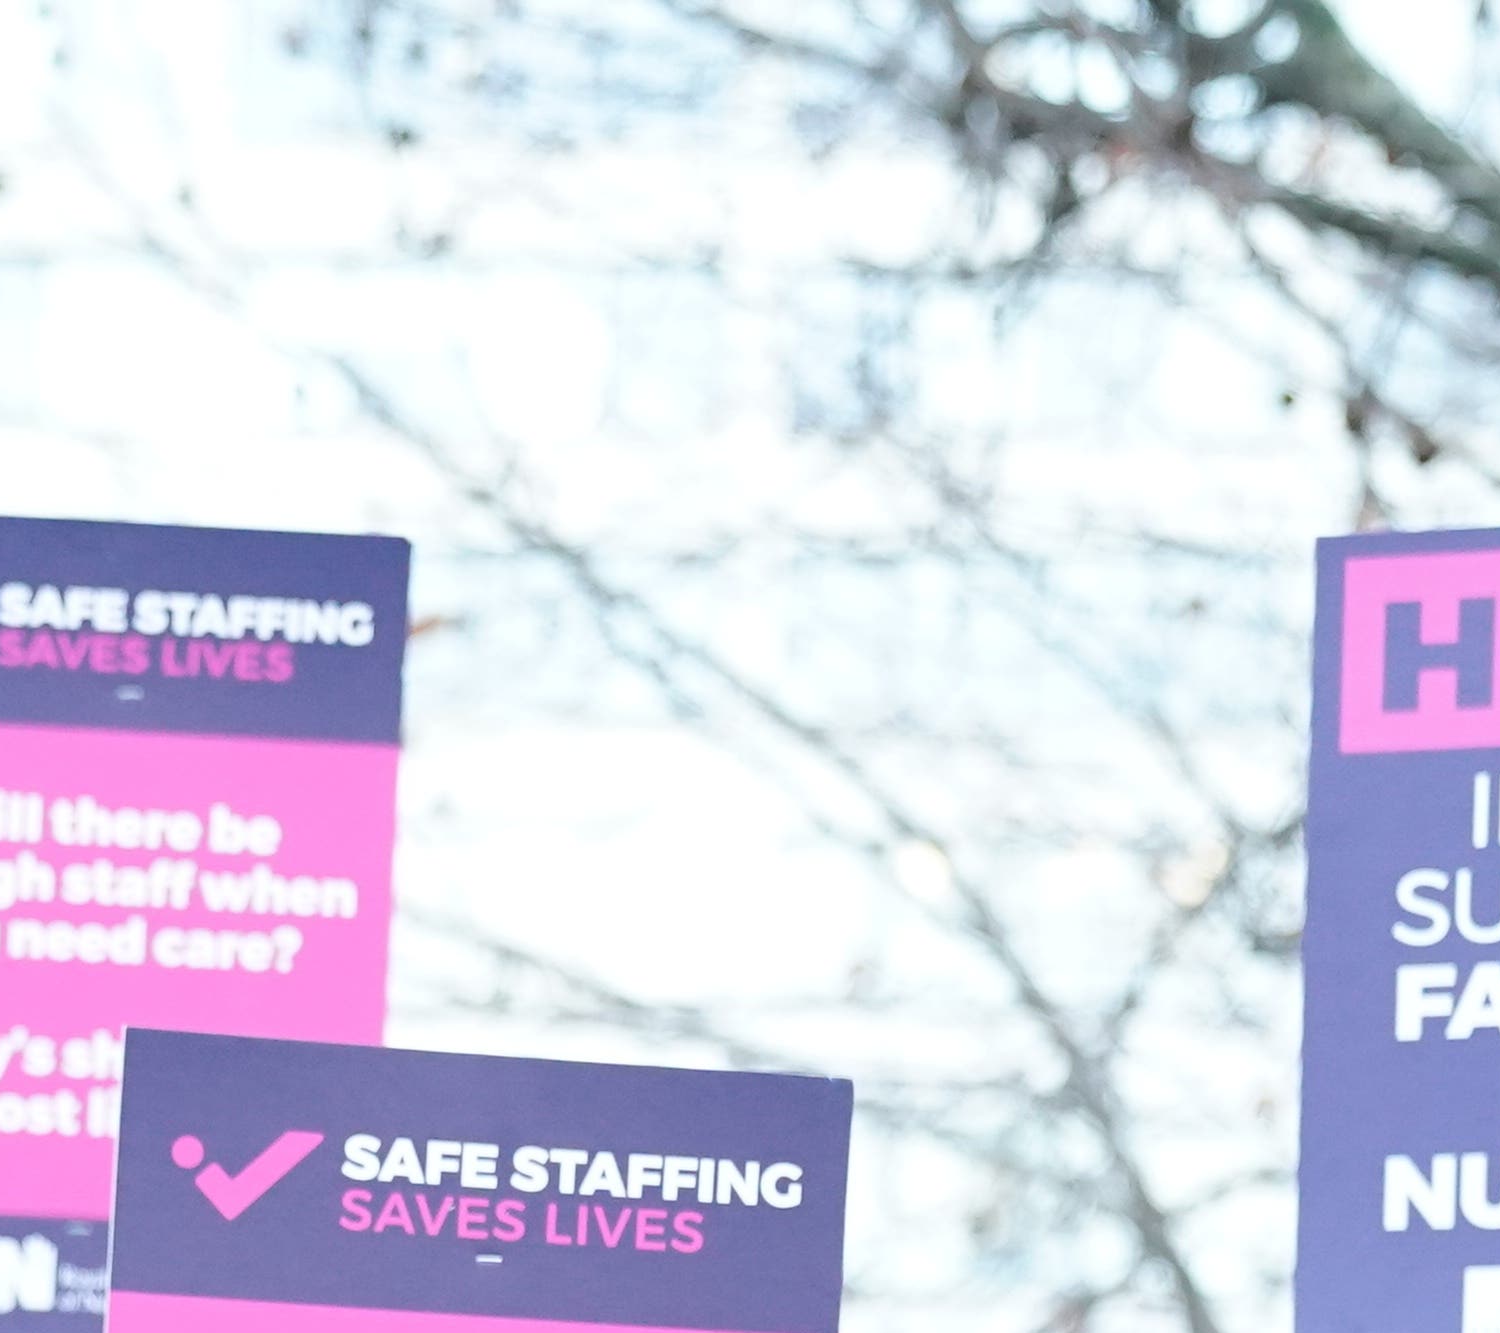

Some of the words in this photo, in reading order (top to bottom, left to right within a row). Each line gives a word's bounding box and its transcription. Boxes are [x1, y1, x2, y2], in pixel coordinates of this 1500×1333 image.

[138, 588, 374, 648] STAFFING
[161, 637, 296, 684] LIVES
[51, 793, 201, 853] there
[211, 802, 282, 857] be
[61, 853, 199, 910] staff
[199, 862, 358, 918] when
[7, 908, 144, 966] need
[152, 923, 304, 975] care?
[342, 1133, 497, 1190] SAFE
[511, 1144, 803, 1211] STAFFING
[339, 1189, 526, 1243] SAVES
[547, 1202, 705, 1255] LIVES
